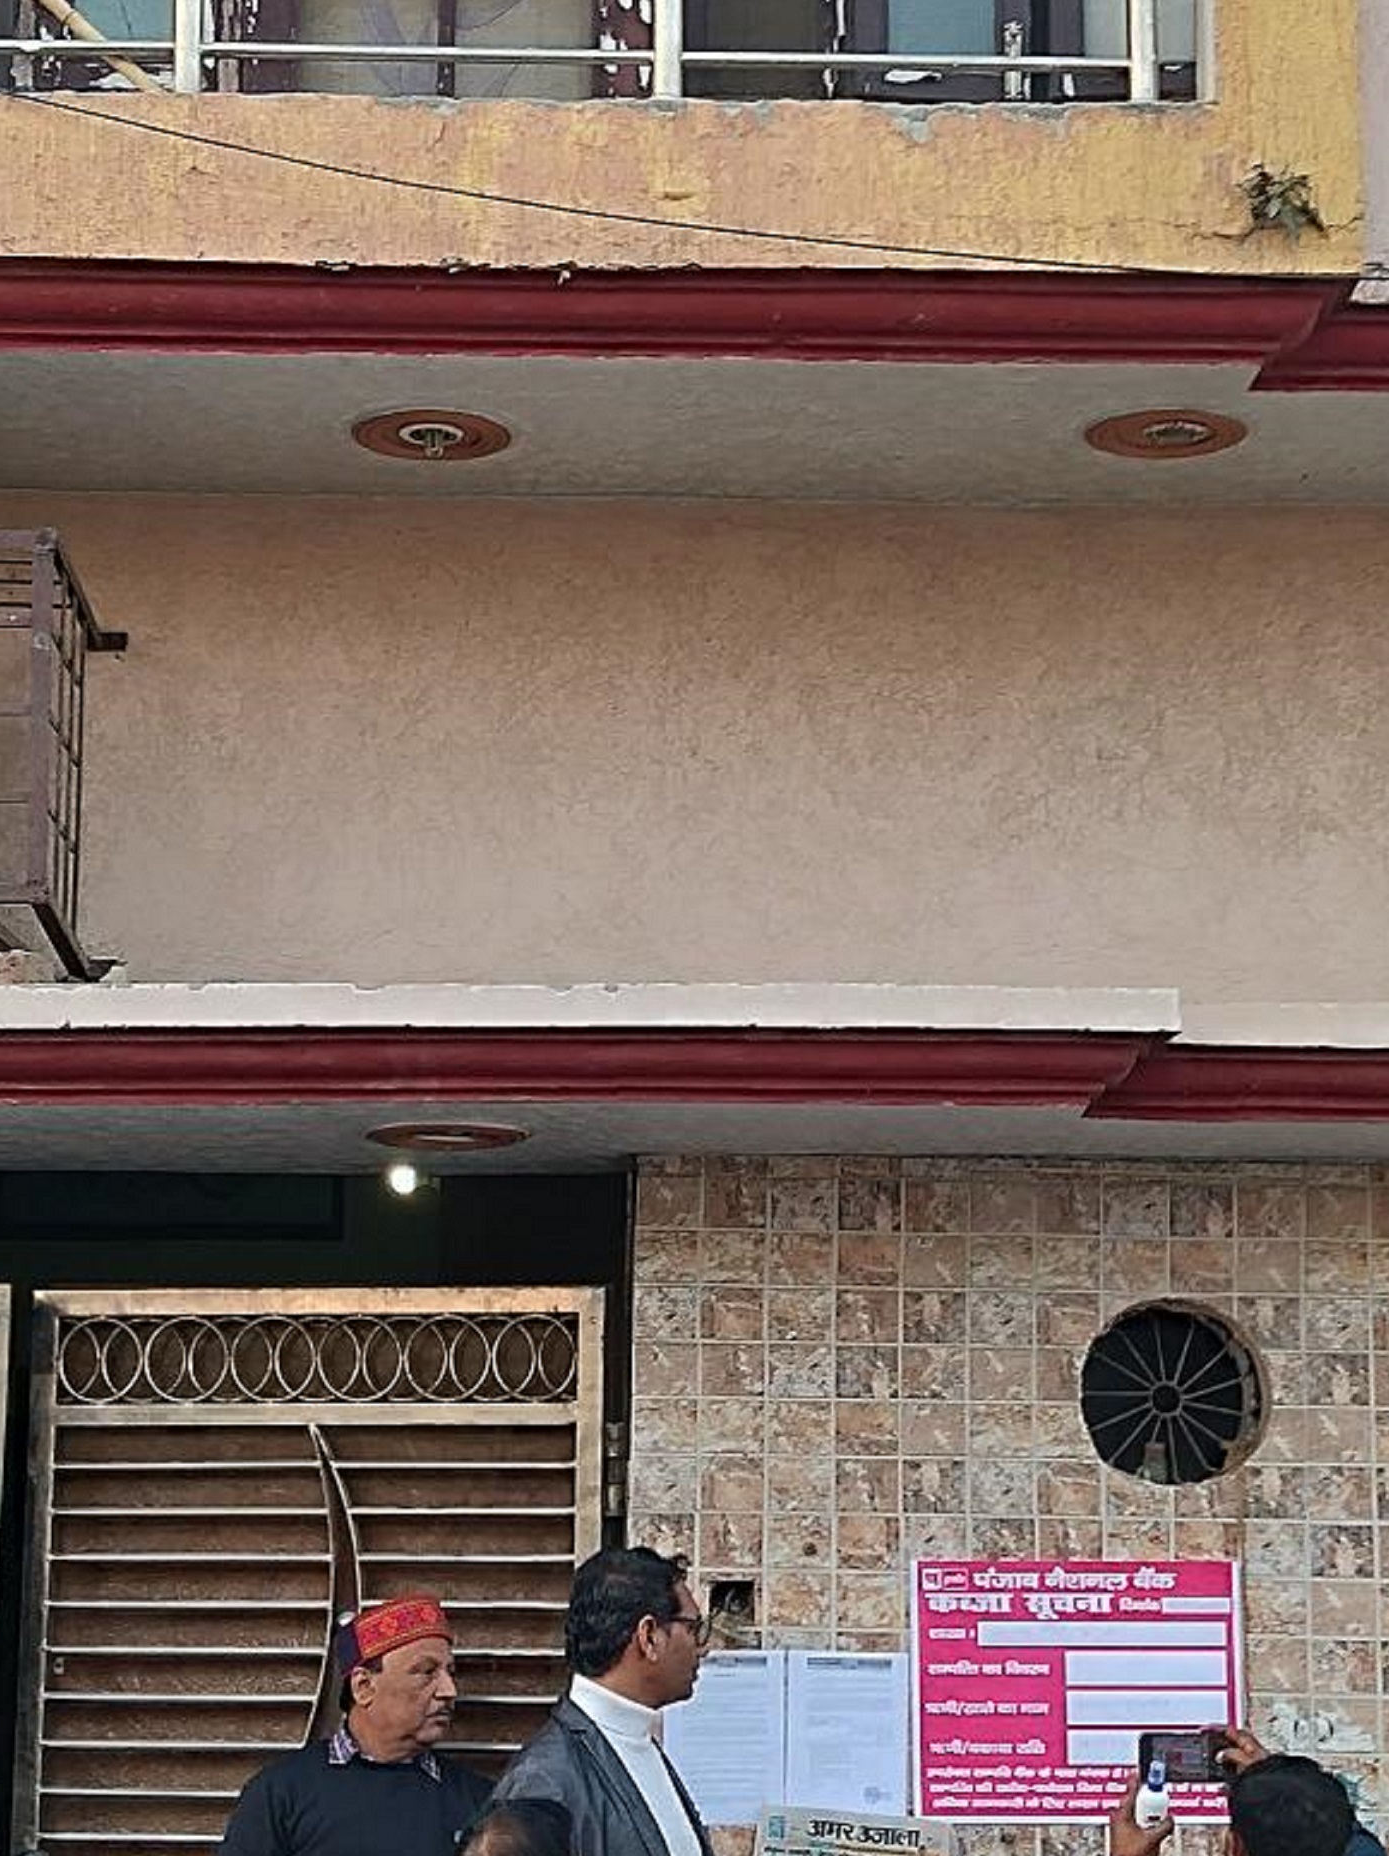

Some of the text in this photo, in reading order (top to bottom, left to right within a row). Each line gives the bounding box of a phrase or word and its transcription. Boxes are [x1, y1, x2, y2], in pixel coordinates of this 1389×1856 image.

[973, 1567, 1039, 1590] पंजाब
[1023, 1593, 1115, 1620] सूचना
[807, 1819, 921, 1848] अमर उजाला
